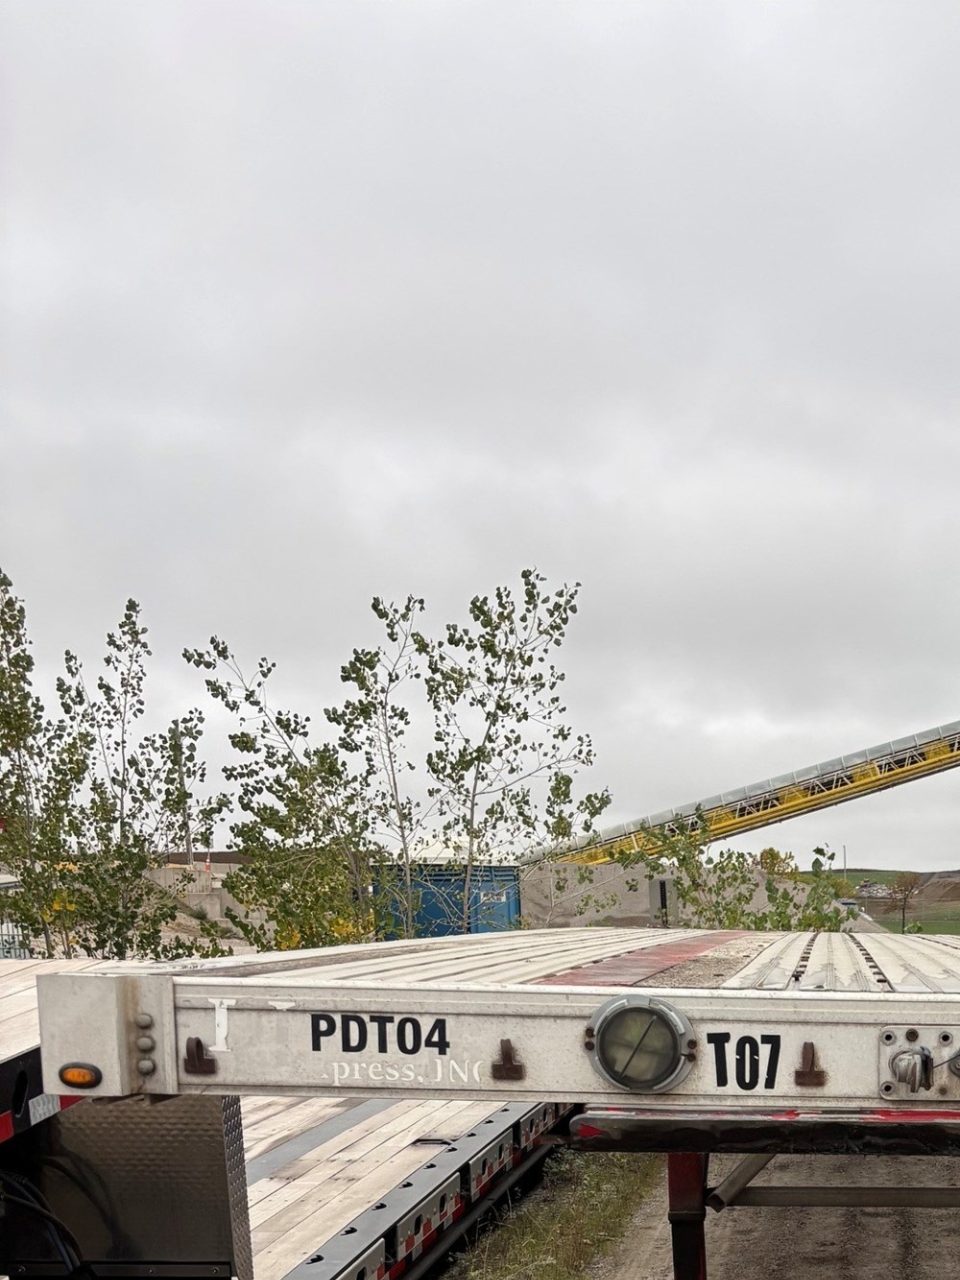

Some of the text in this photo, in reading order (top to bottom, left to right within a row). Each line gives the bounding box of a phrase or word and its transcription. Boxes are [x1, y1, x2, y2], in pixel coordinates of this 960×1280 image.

[310, 1013, 451, 1056] PDT04
[321, 1060, 424, 1087] press,
[706, 1032, 782, 1091] T07
